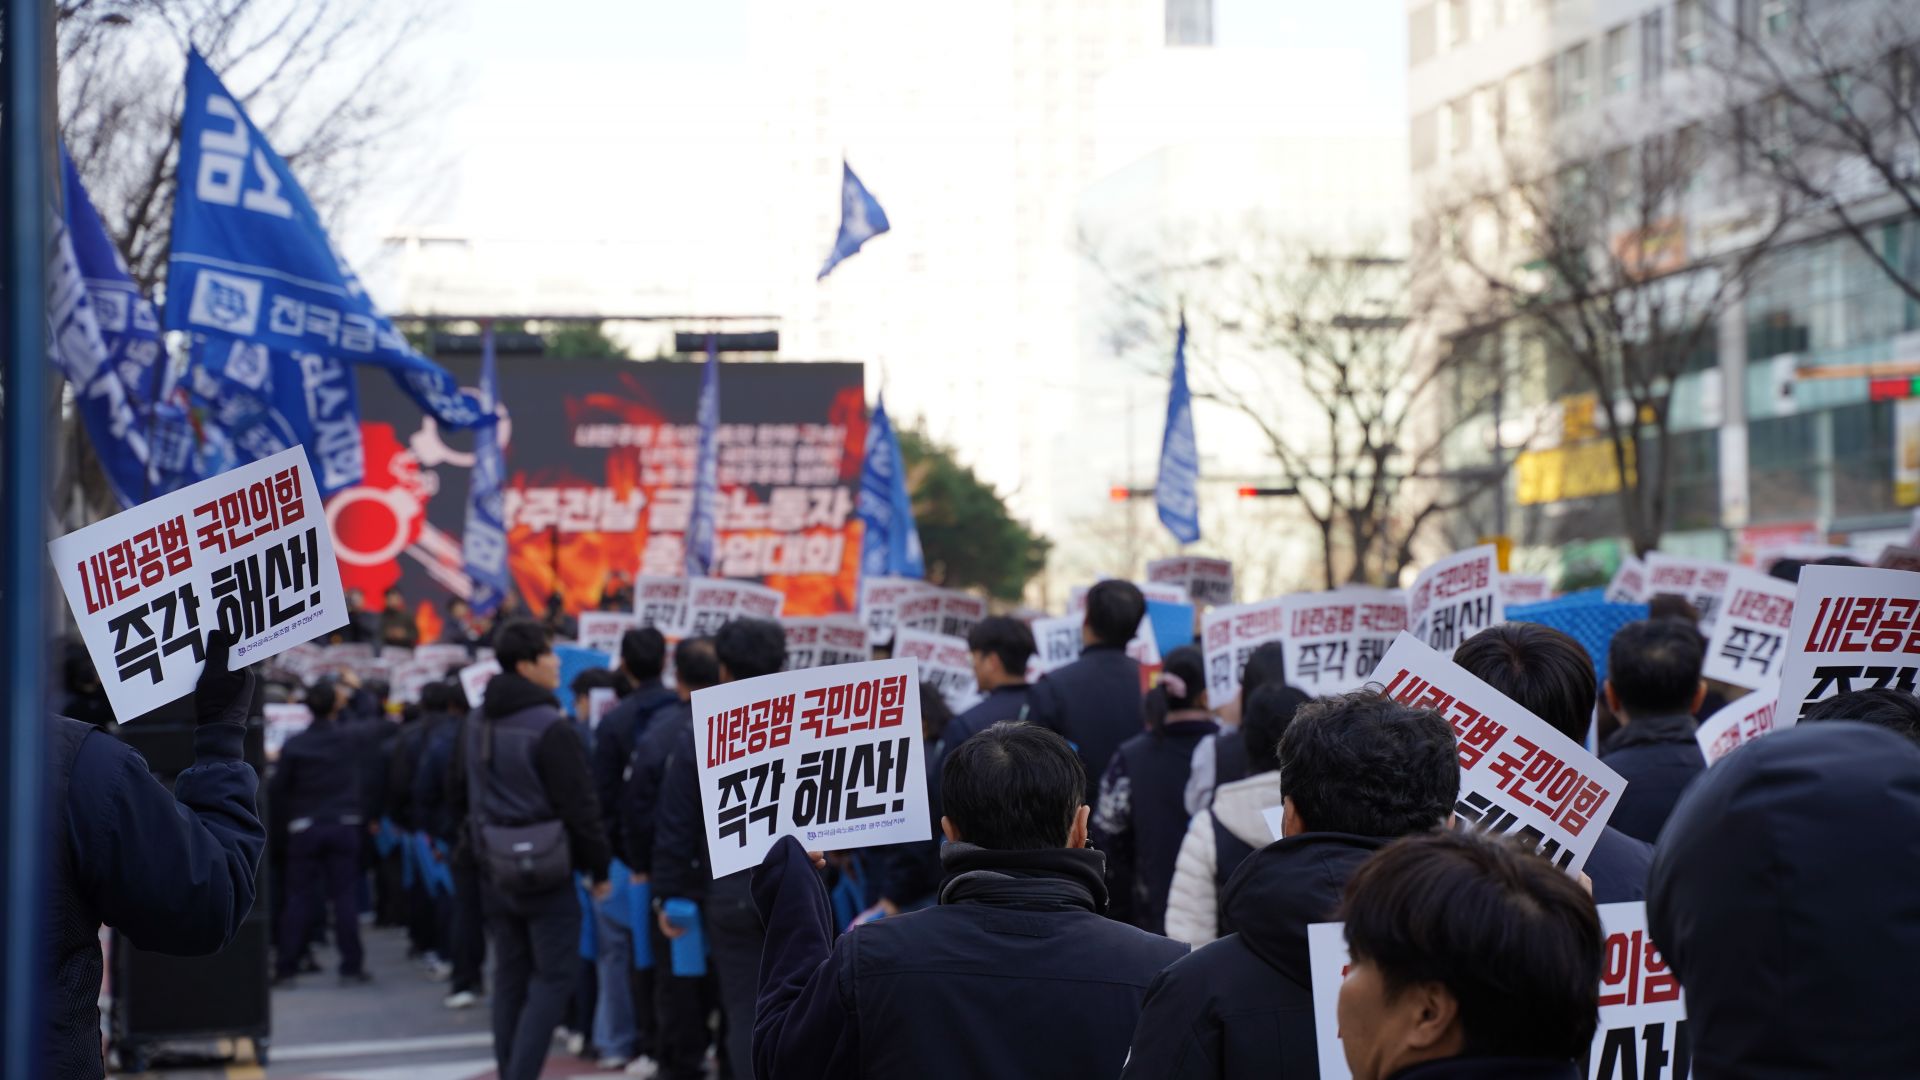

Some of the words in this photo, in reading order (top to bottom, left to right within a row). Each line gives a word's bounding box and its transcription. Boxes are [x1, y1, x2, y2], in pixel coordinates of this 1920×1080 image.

[77, 514, 193, 615] 내란공범
[193, 465, 305, 554] 국민의힘
[108, 582, 206, 685] 즉각
[210, 527, 322, 648] 해산!
[1290, 603, 1356, 638] 내란공범
[1719, 626, 1783, 676] 즉각
[1296, 639, 1350, 685] 즉각
[1355, 636, 1396, 679] 해
[707, 693, 796, 769] 내란공범
[800, 674, 908, 739] 국민의힘
[718, 758, 785, 848] 즉각
[791, 736, 911, 828] 해산!
[1487, 735, 1611, 838] 국민의힘
